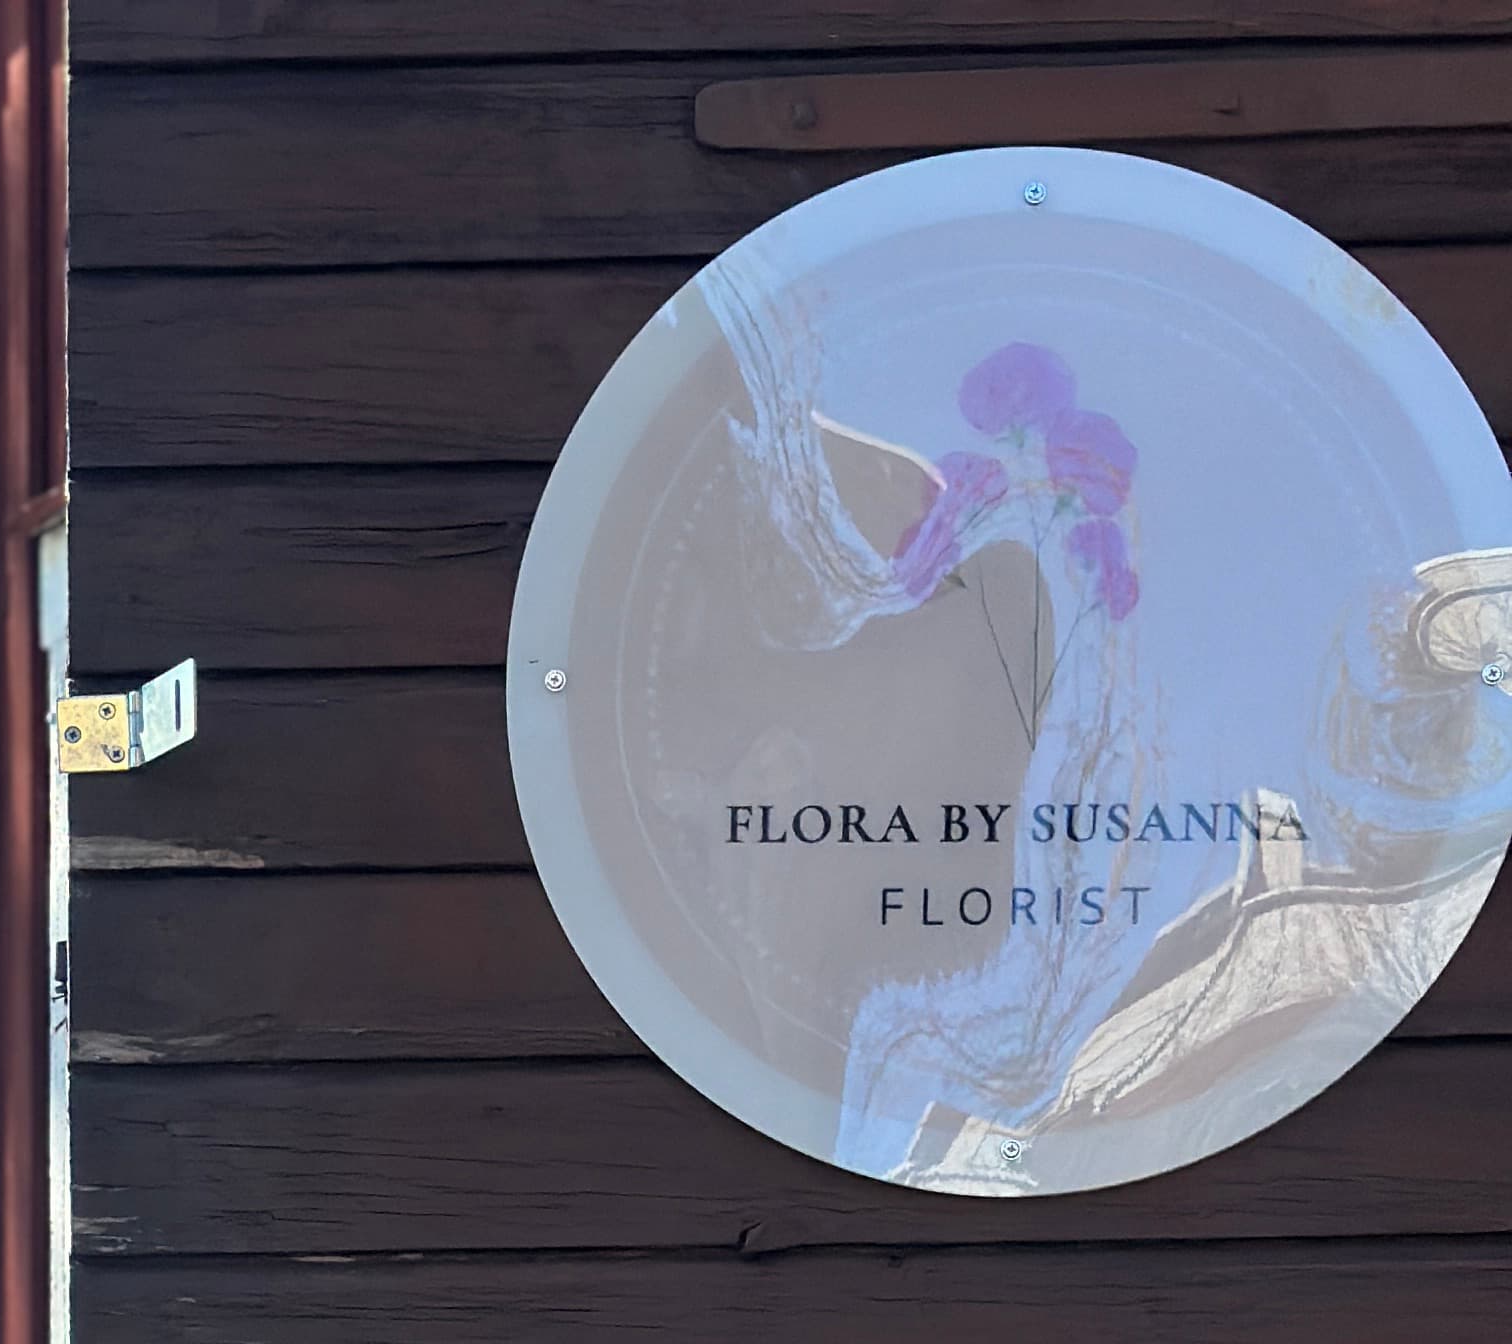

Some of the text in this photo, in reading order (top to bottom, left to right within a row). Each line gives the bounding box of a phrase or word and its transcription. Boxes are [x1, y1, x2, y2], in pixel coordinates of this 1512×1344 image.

[725, 803, 1309, 843] FLORA BY SUSANNA
[881, 887, 1151, 926] FLORIST
